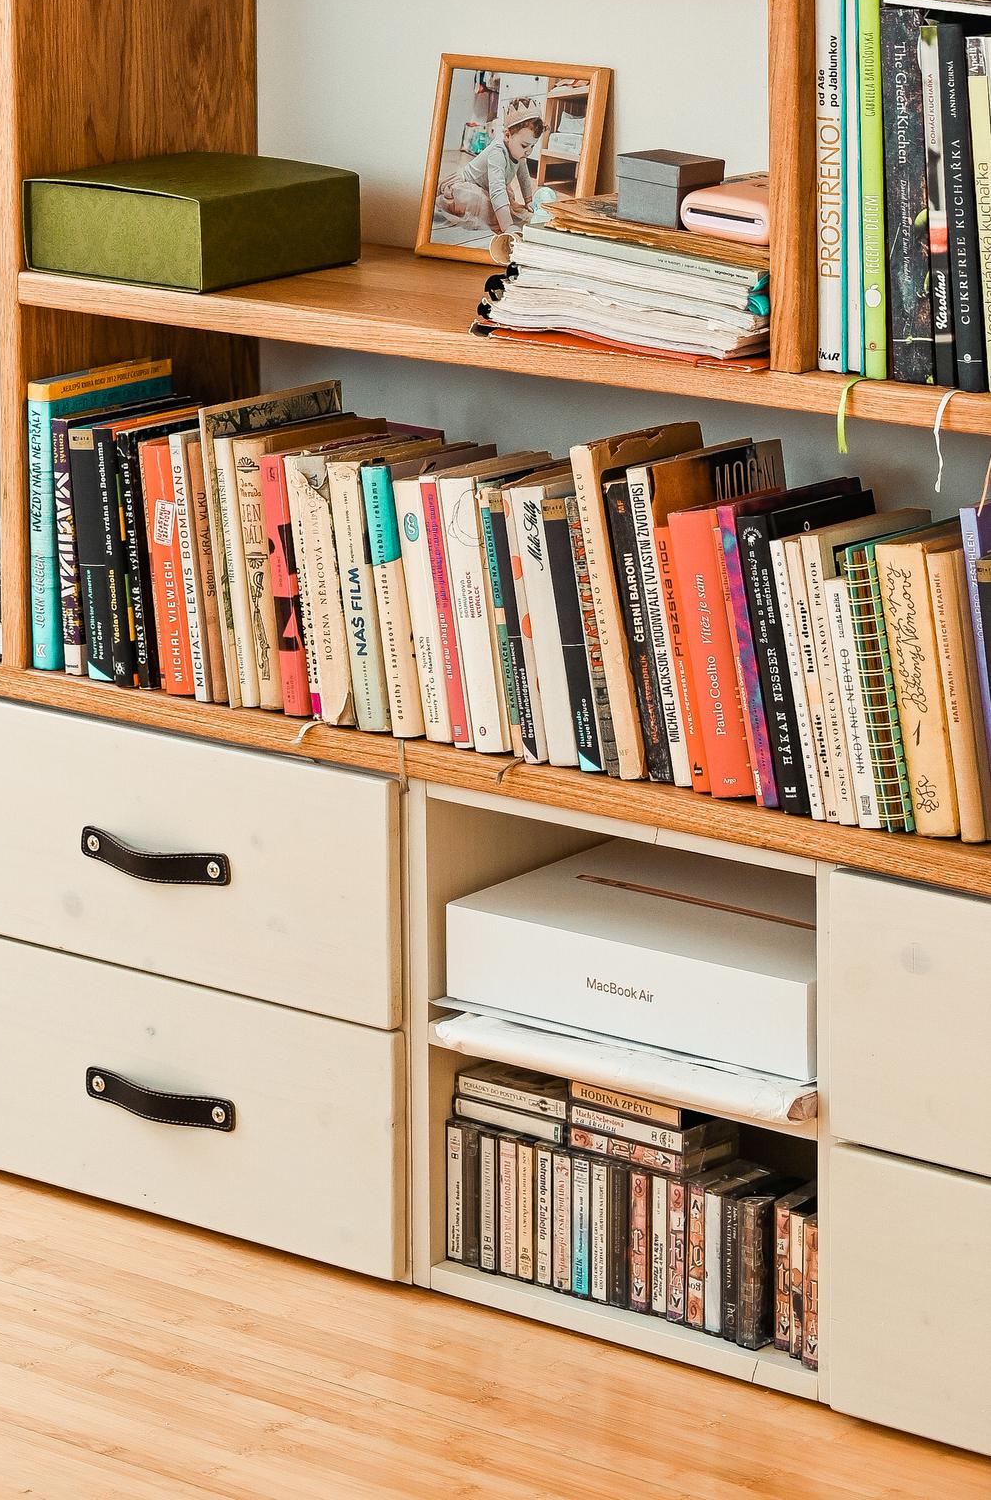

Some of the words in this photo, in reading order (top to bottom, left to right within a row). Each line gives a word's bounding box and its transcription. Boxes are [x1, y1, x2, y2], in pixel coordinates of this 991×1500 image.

[817, 69, 825, 89] Aše
[828, 35, 840, 92] Jablunkov
[817, 93, 826, 106] od
[830, 95, 840, 107] po
[816, 115, 843, 278] PROSTŘENO!
[30, 410, 42, 461] NEPŘÁLY
[30, 463, 43, 488] NÁM
[30, 490, 43, 532] HVĚZDY
[172, 465, 191, 559] BOOMERANG
[631, 483, 651, 537] ŽIVOTOPIS]
[32, 554, 45, 594] GREEN
[623, 553, 641, 601] BARONI
[638, 540, 659, 585] [VLASTNÍ
[163, 561, 177, 623] VIEWEGH
[183, 567, 198, 614] LEWIS
[347, 567, 363, 611] FILM
[693, 574, 708, 597] sám
[697, 601, 710, 612] je
[34, 599, 46, 628] JOHN
[629, 604, 645, 643] ČERNÍ
[648, 588, 667, 647] MOONWALK
[698, 615, 713, 644] Vítěz
[168, 626, 183, 682] MICHAL
[189, 617, 204, 687] MICHAEL
[350, 616, 369, 656] NÁŠ
[656, 649, 674, 697] JACKSON:
[705, 656, 721, 698] Coelho
[766, 647, 783, 702] NESSER
[663, 700, 680, 743] MICHAEL
[713, 702, 727, 735] Paulo
[776, 711, 793, 765] HÅKAN
[586, 977, 638, 999] MacBook
[639, 989, 654, 1003] Air
[580, 1087, 620, 1108] HODINA
[621, 1098, 653, 1117] ZPĚVU
